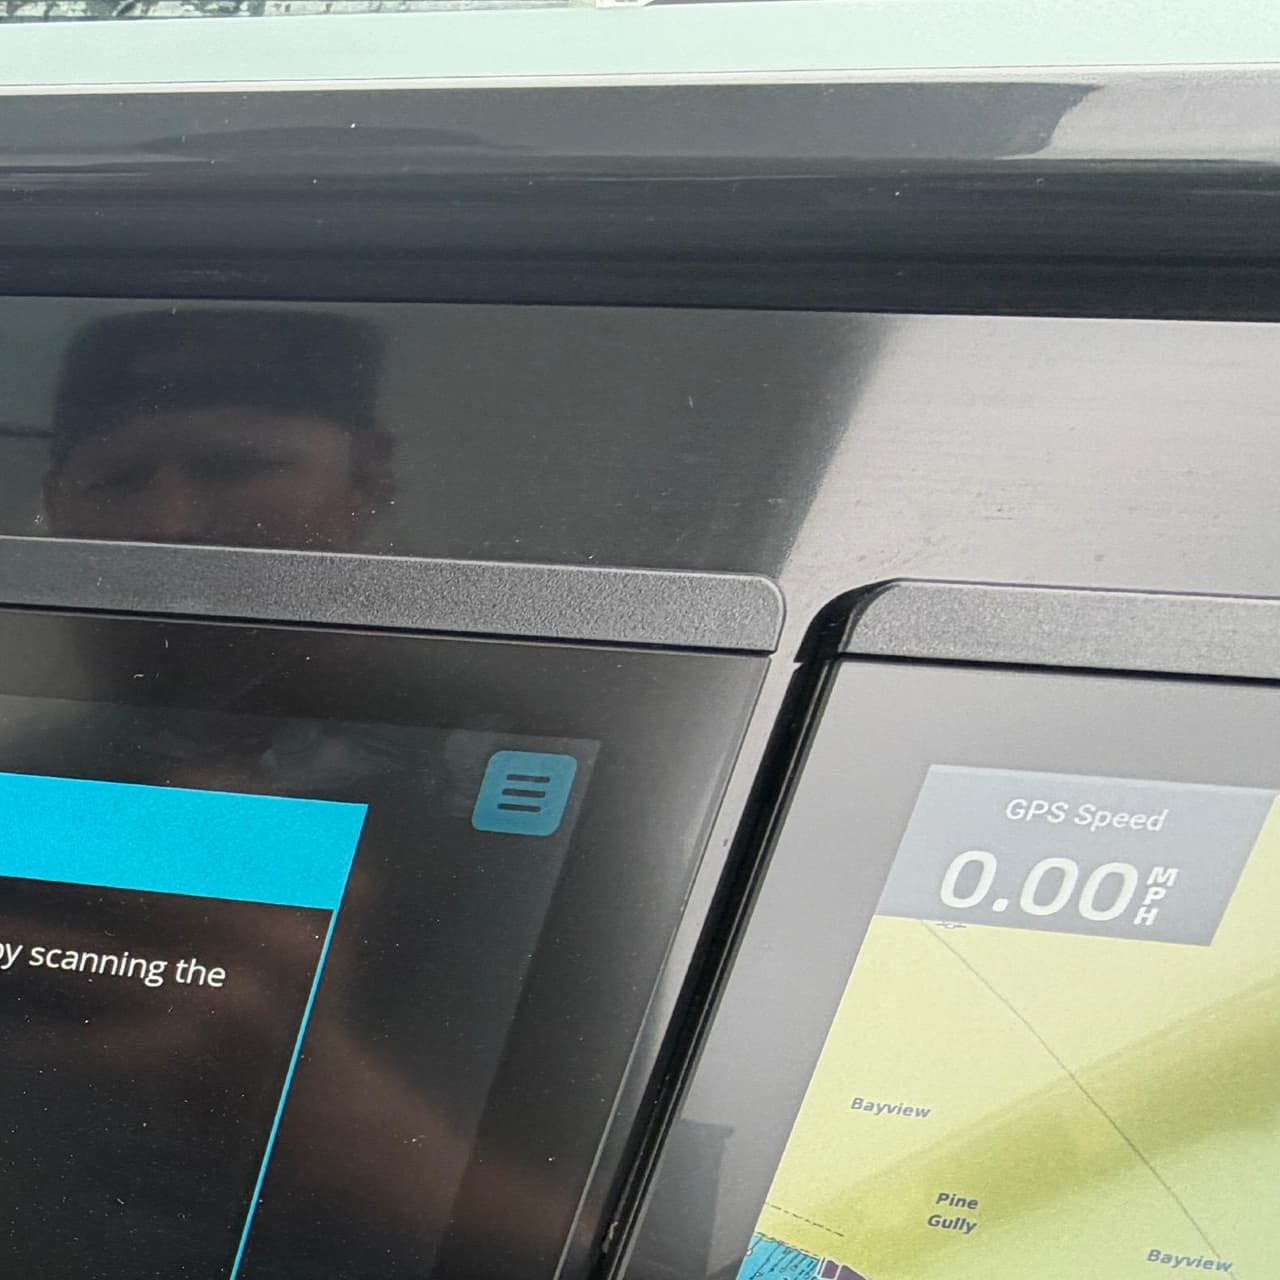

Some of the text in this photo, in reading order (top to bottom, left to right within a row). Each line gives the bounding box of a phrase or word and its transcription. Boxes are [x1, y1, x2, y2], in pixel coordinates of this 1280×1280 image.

[1005, 798, 1170, 832] GPS Speed
[940, 850, 1139, 922] 0.00
[28, 942, 165, 989] scanning
[175, 957, 228, 990] the
[850, 1096, 932, 1119] Bayview
[935, 1192, 979, 1210] Pine
[926, 1213, 978, 1235] Gully
[1146, 1248, 1233, 1273] Bayview
